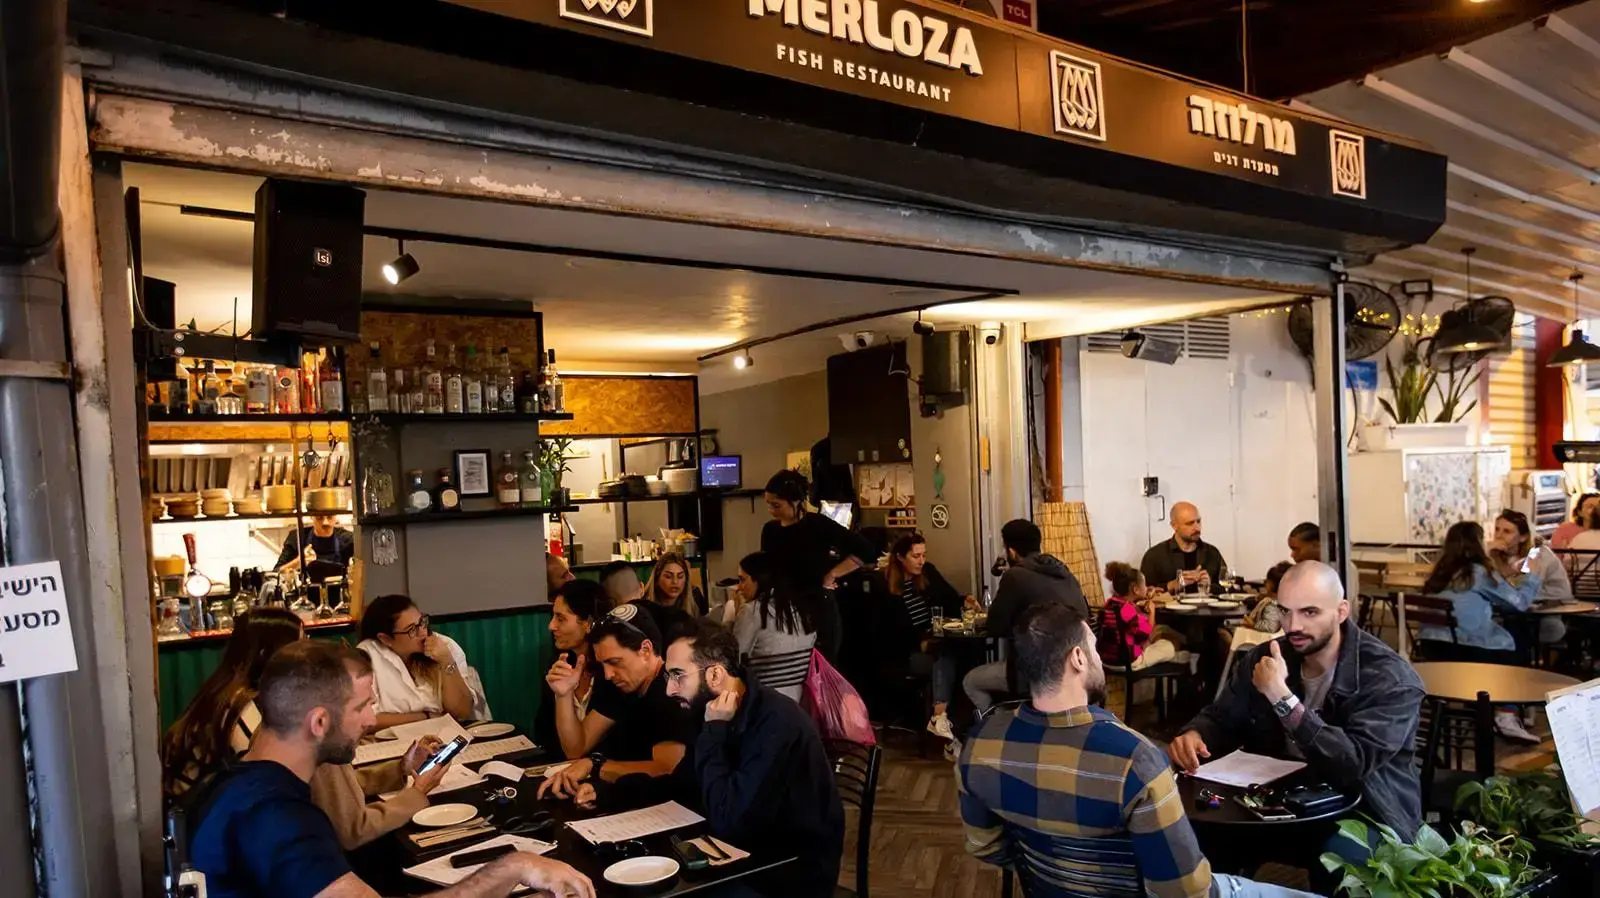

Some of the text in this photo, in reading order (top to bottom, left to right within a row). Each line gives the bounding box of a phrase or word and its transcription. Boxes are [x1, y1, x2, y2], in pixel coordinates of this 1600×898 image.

[1006, 4, 1028, 19] TCL
[776, 44, 951, 102] FISH RESTAURANT
[1188, 94, 1296, 155] מרלוזה
[0, 575, 57, 598] הישי
[0, 609, 60, 633] מסע
